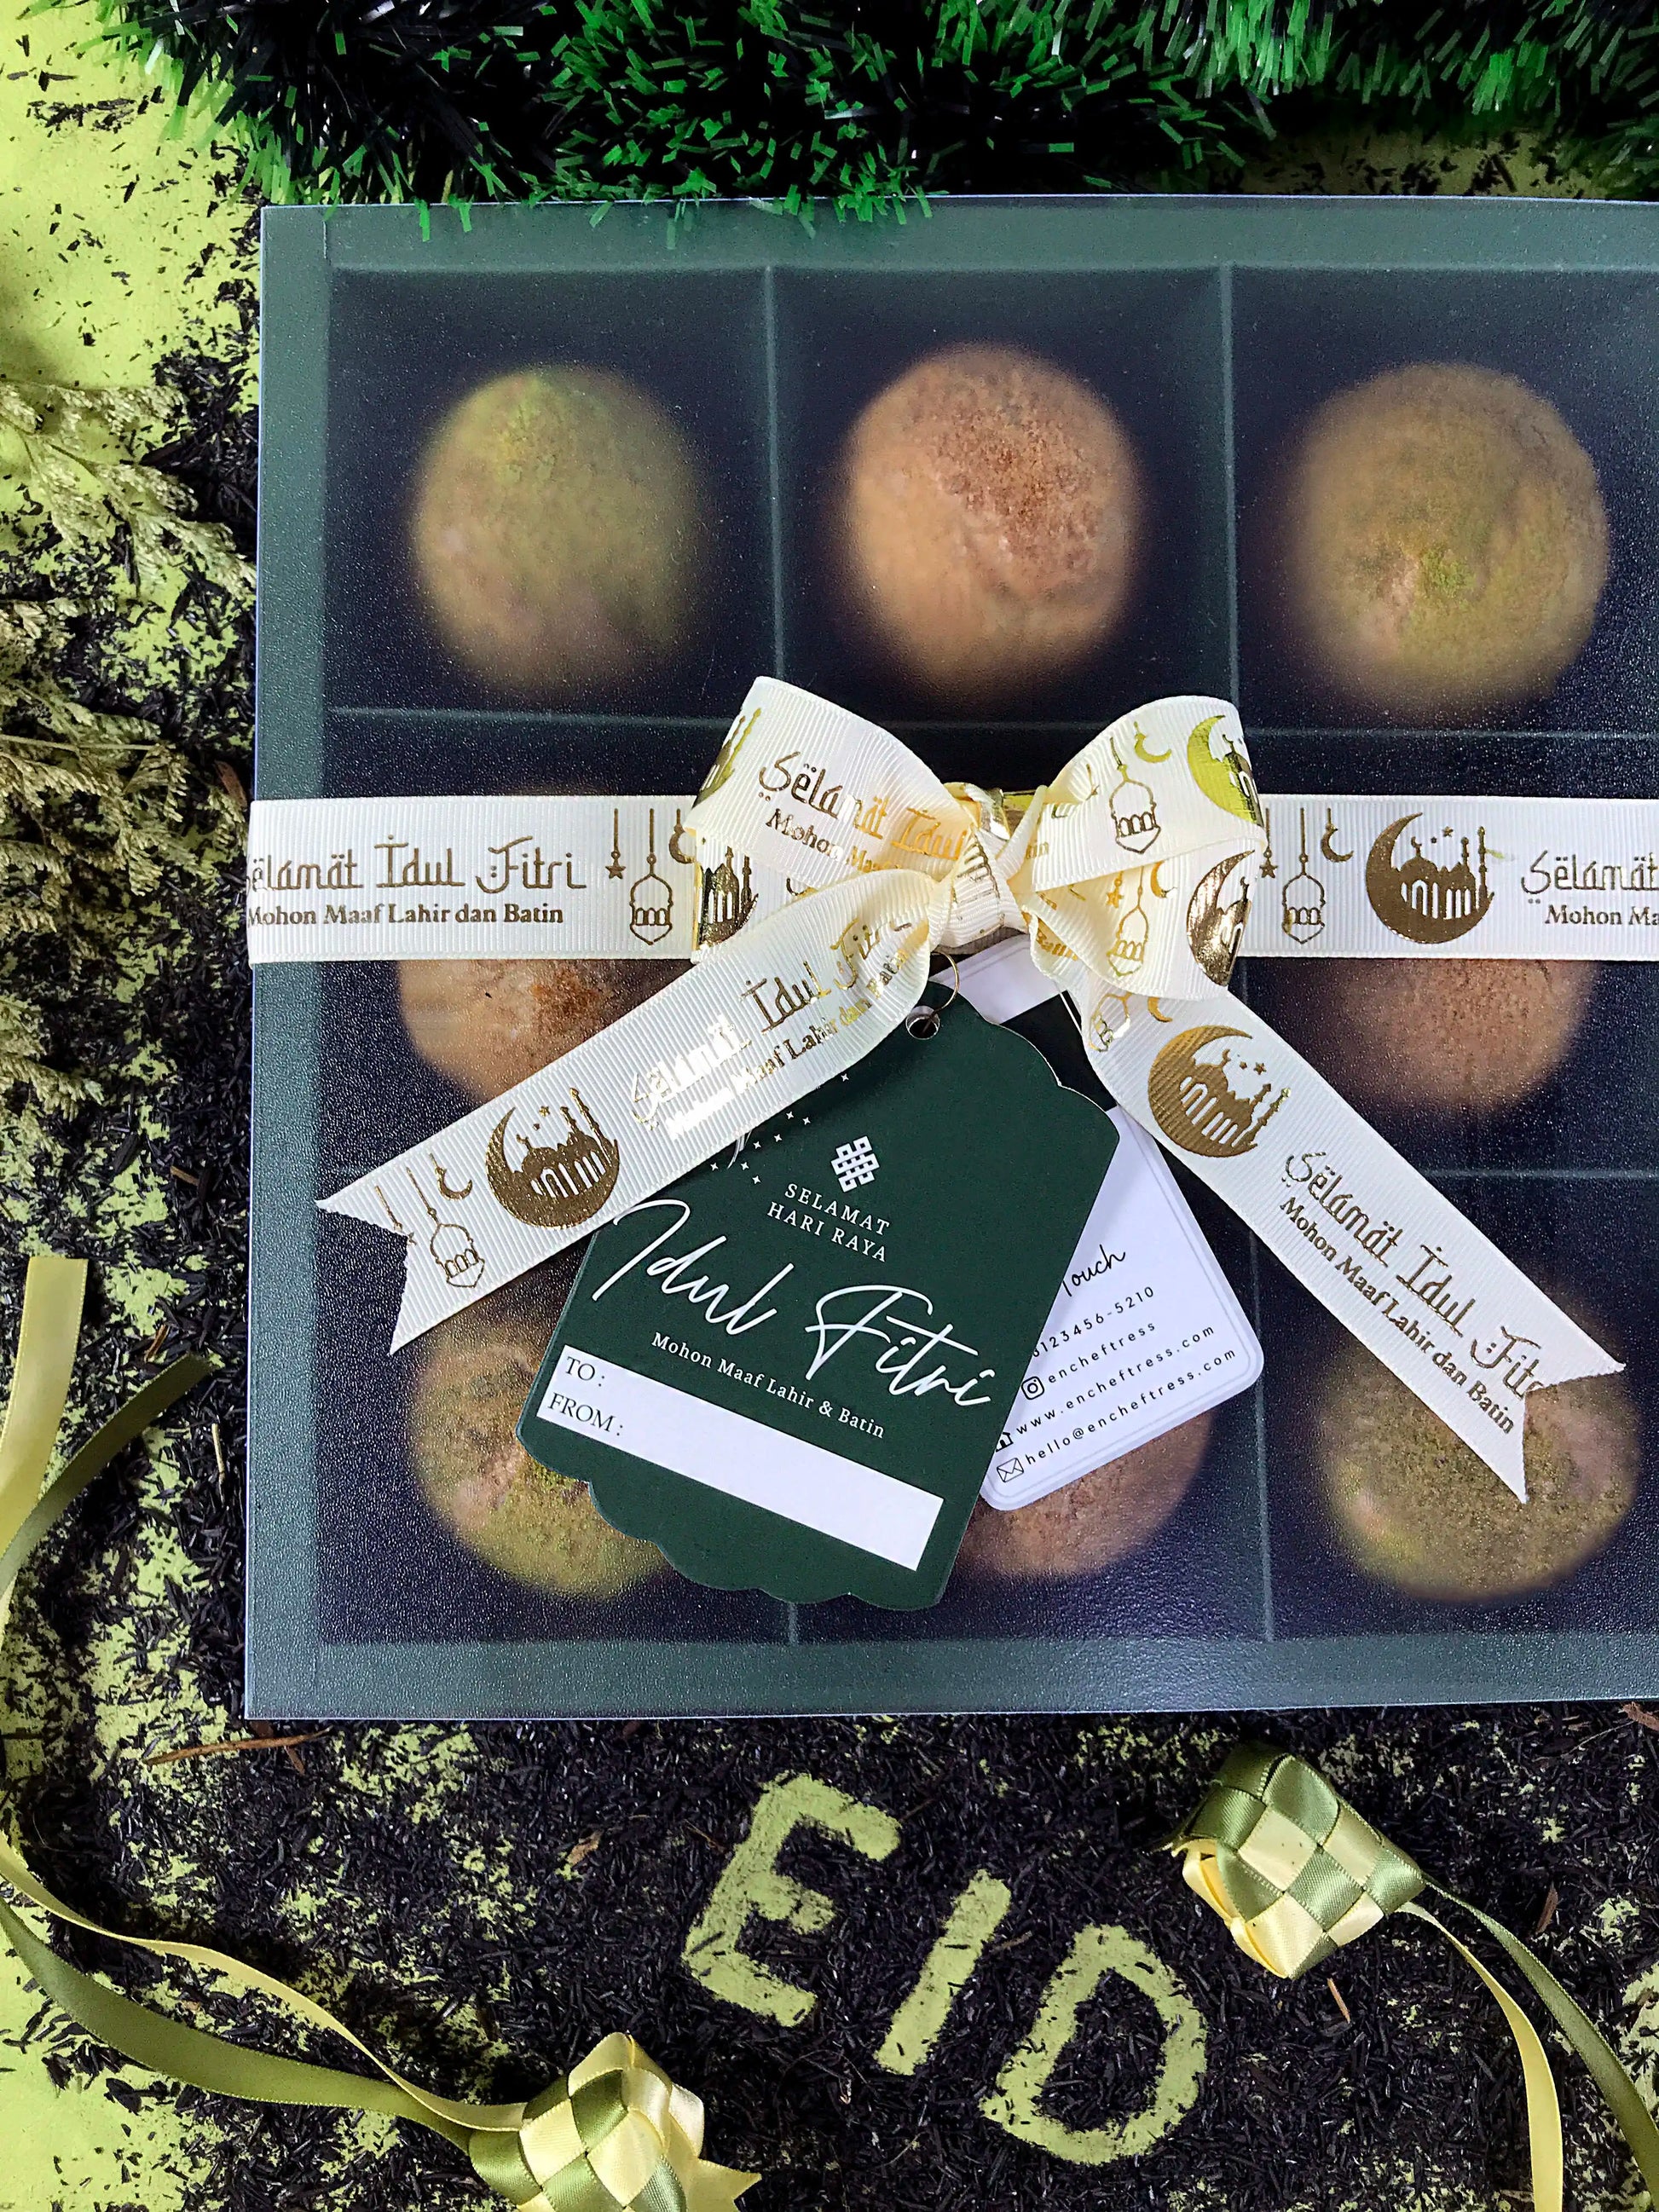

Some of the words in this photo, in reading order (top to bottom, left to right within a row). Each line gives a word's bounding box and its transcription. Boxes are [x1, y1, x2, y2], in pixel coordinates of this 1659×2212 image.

[248, 904, 316, 927] Mohon
[323, 904, 384, 925] Maaf
[388, 903, 450, 923] Lahir
[454, 903, 497, 923] dan
[504, 903, 564, 923] Batin
[1545, 904, 1622, 926] Mohon
[783, 1018, 839, 1060] Lahir
[838, 998, 873, 1027] dan
[766, 1201, 825, 1237] HARI
[830, 1227, 886, 1262] RAYA
[784, 1182, 890, 1236] SELAMAT
[592, 1199, 795, 1336] Idul
[805, 1285, 996, 1406] Fitri
[1280, 1197, 1337, 1262] Mohon
[1334, 1255, 1387, 1307] Maaf
[1382, 1298, 1435, 1354] Lahir
[1432, 1351, 1467, 1387] dan
[1466, 1380, 1514, 1435] Batin
[651, 1331, 712, 1368] Mohon
[716, 1359, 766, 1389] Maaf
[766, 1378, 815, 1409] Lahir
[818, 1401, 833, 1418] &
[837, 1407, 886, 1440] Batin
[1016, 1325, 1215, 1435] www.encheftress.com
[1048, 1323, 1156, 1383] encheftress
[1026, 1349, 1236, 1466] hello@encheftress.com
[681, 1771, 1208, 2165] EID
